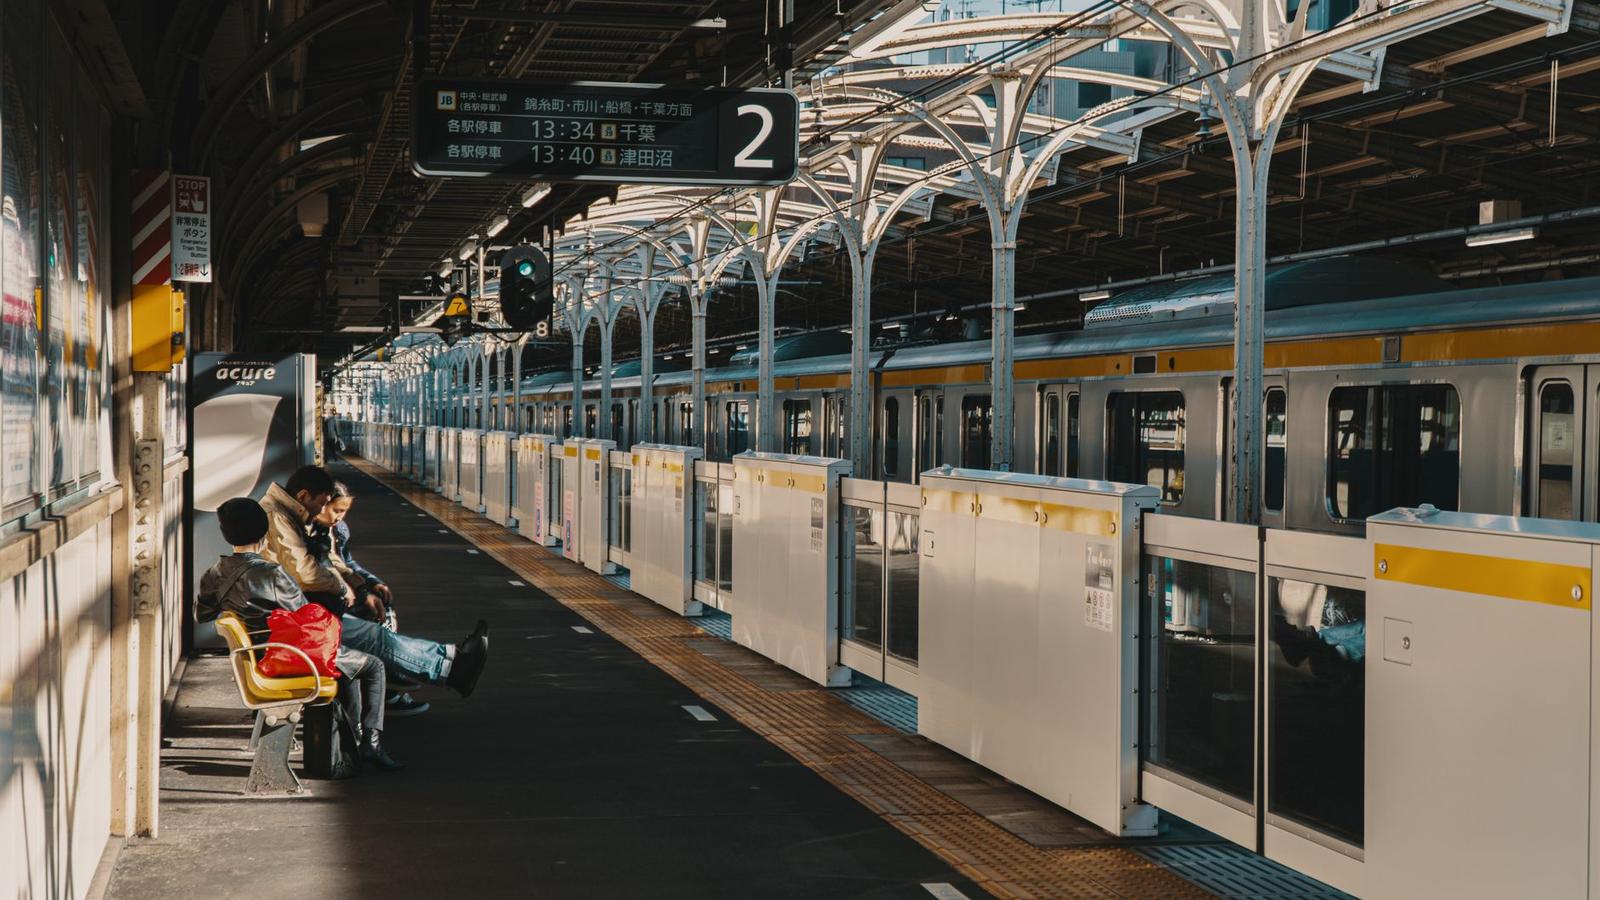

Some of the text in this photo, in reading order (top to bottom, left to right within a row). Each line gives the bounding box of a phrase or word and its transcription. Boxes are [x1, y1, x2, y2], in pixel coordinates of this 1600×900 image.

[440, 96, 453, 105] JB
[448, 119, 502, 134] 各駅停車
[531, 119, 596, 140] 13:34
[620, 124, 656, 142] 千葉
[734, 104, 775, 169] 2
[447, 144, 502, 159] 各駅停車
[531, 145, 595, 165] 13:40
[619, 148, 673, 167] 津田沼
[177, 179, 206, 191] STOP
[184, 228, 207, 239] ボタン
[536, 321, 548, 337] 8
[216, 367, 276, 380] acure
